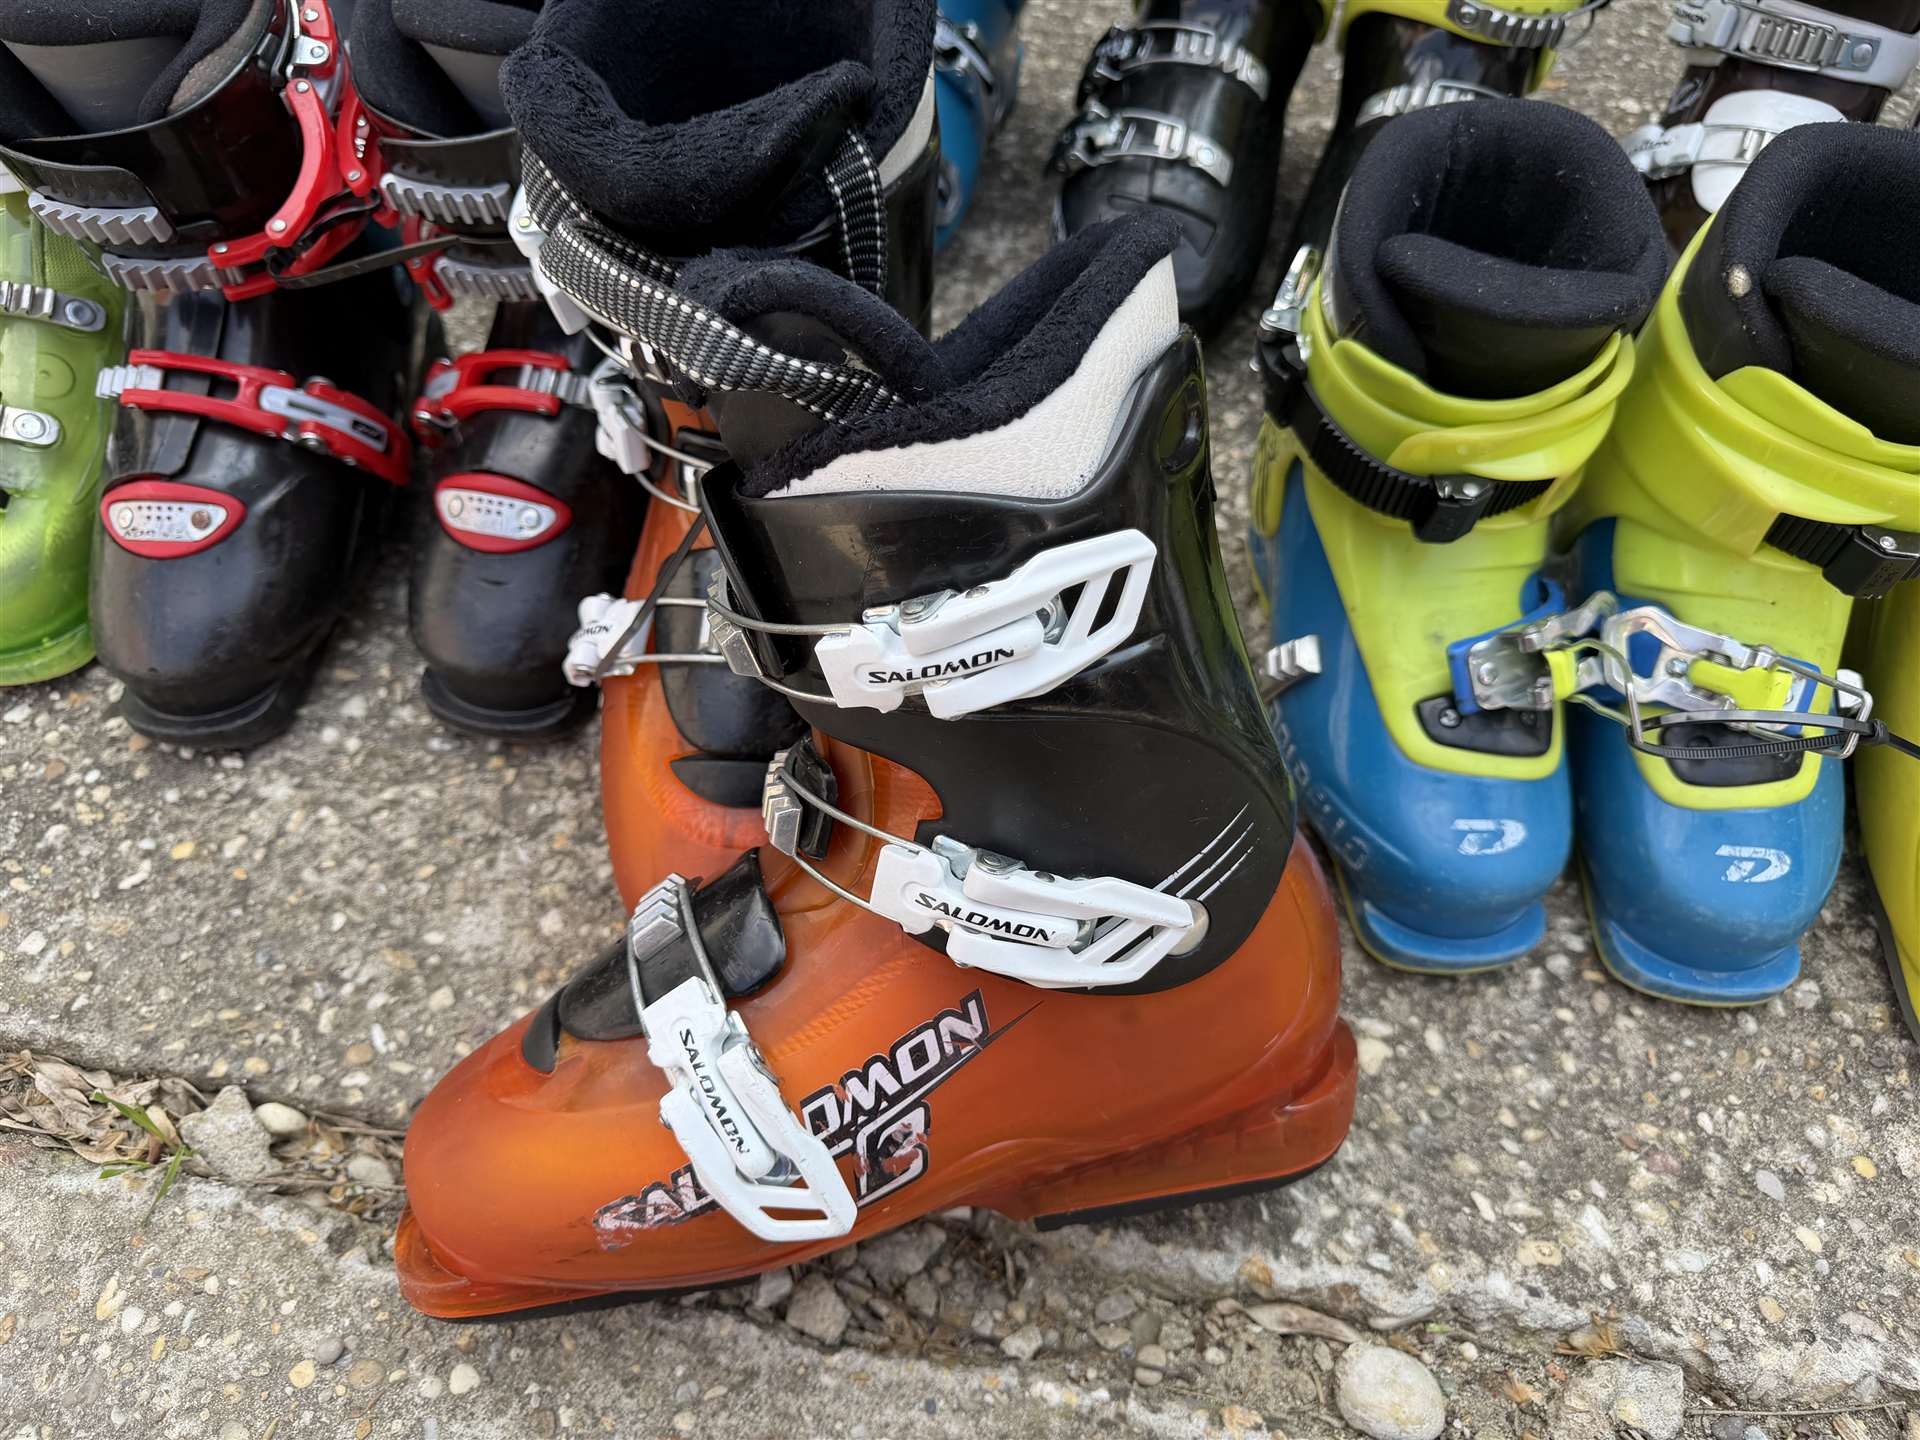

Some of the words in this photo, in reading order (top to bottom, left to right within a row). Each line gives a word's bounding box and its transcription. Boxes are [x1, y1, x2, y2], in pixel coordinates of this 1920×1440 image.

[868, 648, 1014, 684] SALOMON
[915, 892, 1055, 942] SALOMON
[680, 1028, 750, 1153] SALOMON
